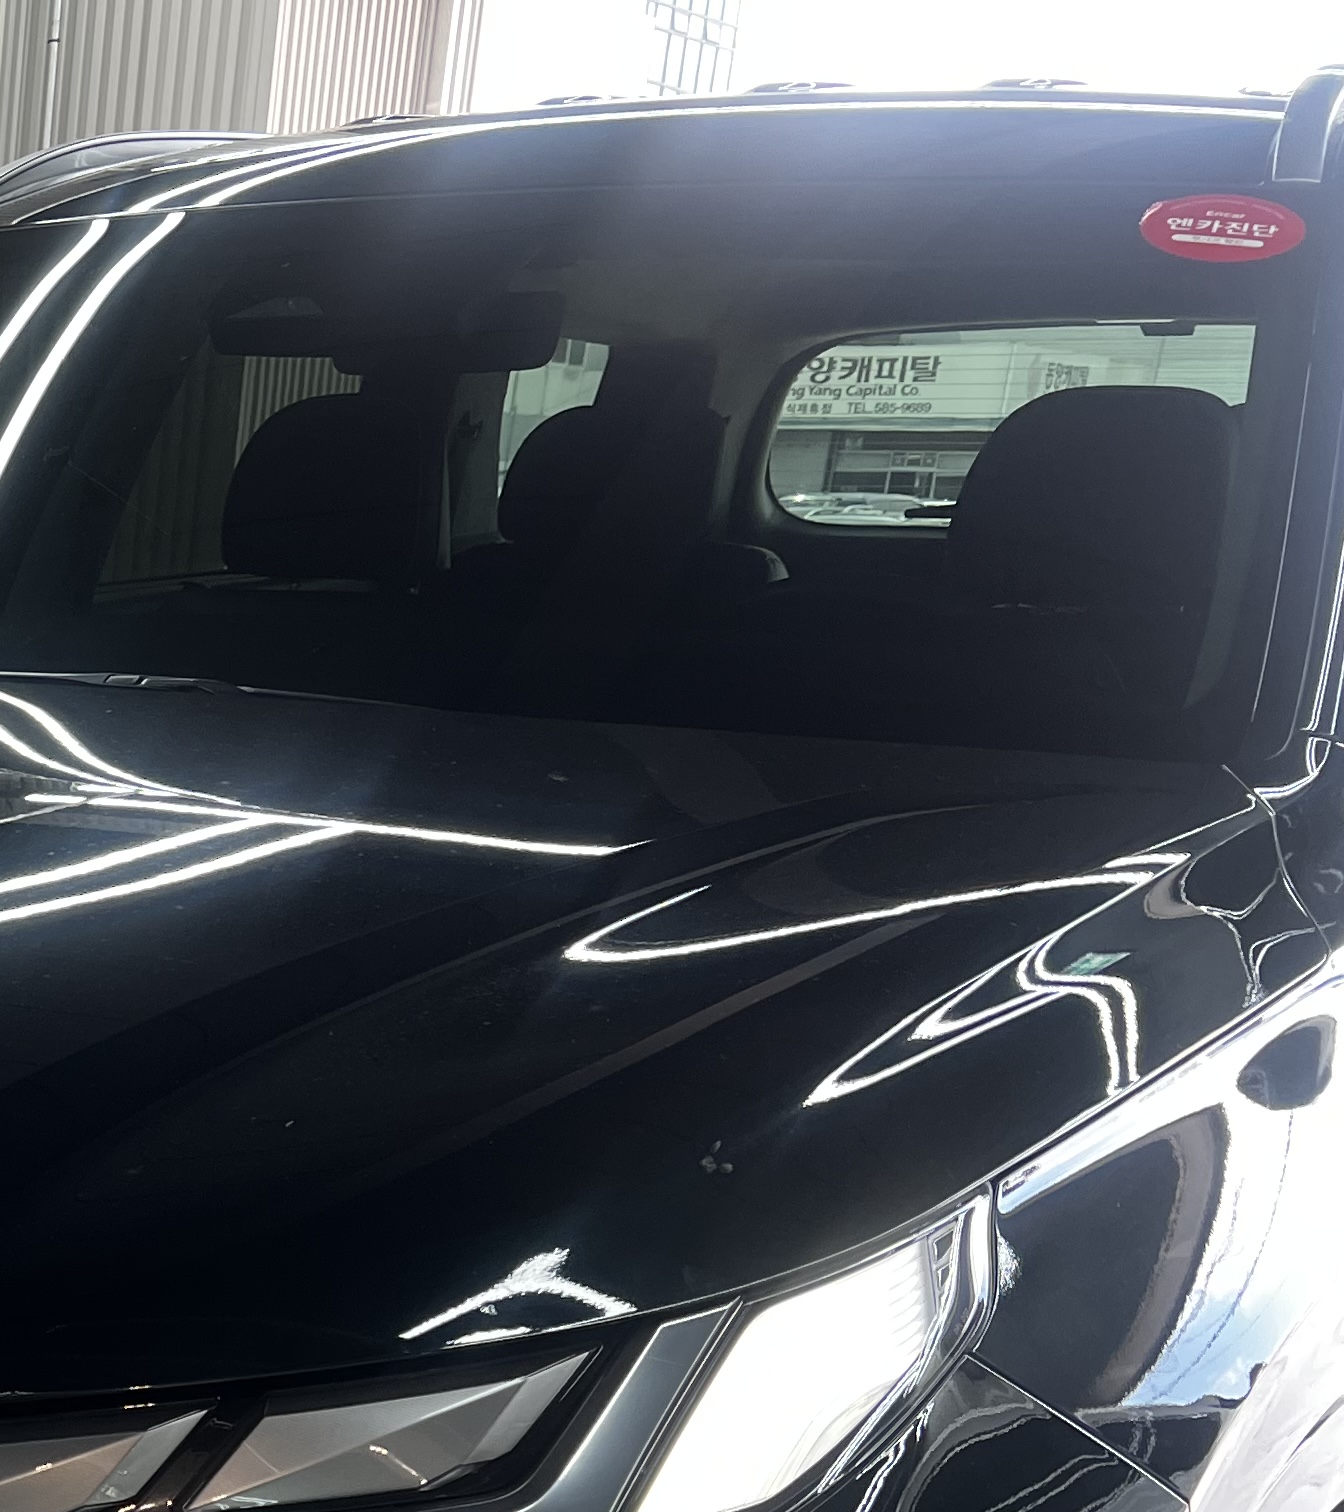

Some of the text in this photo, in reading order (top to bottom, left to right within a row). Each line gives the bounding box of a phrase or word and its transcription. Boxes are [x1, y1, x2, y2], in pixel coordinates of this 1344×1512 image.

[1166, 216, 1279, 238] 엔카진단
[796, 356, 942, 383] 양캐피탈
[809, 385, 842, 400] Yang
[846, 384, 896, 400] Capital
